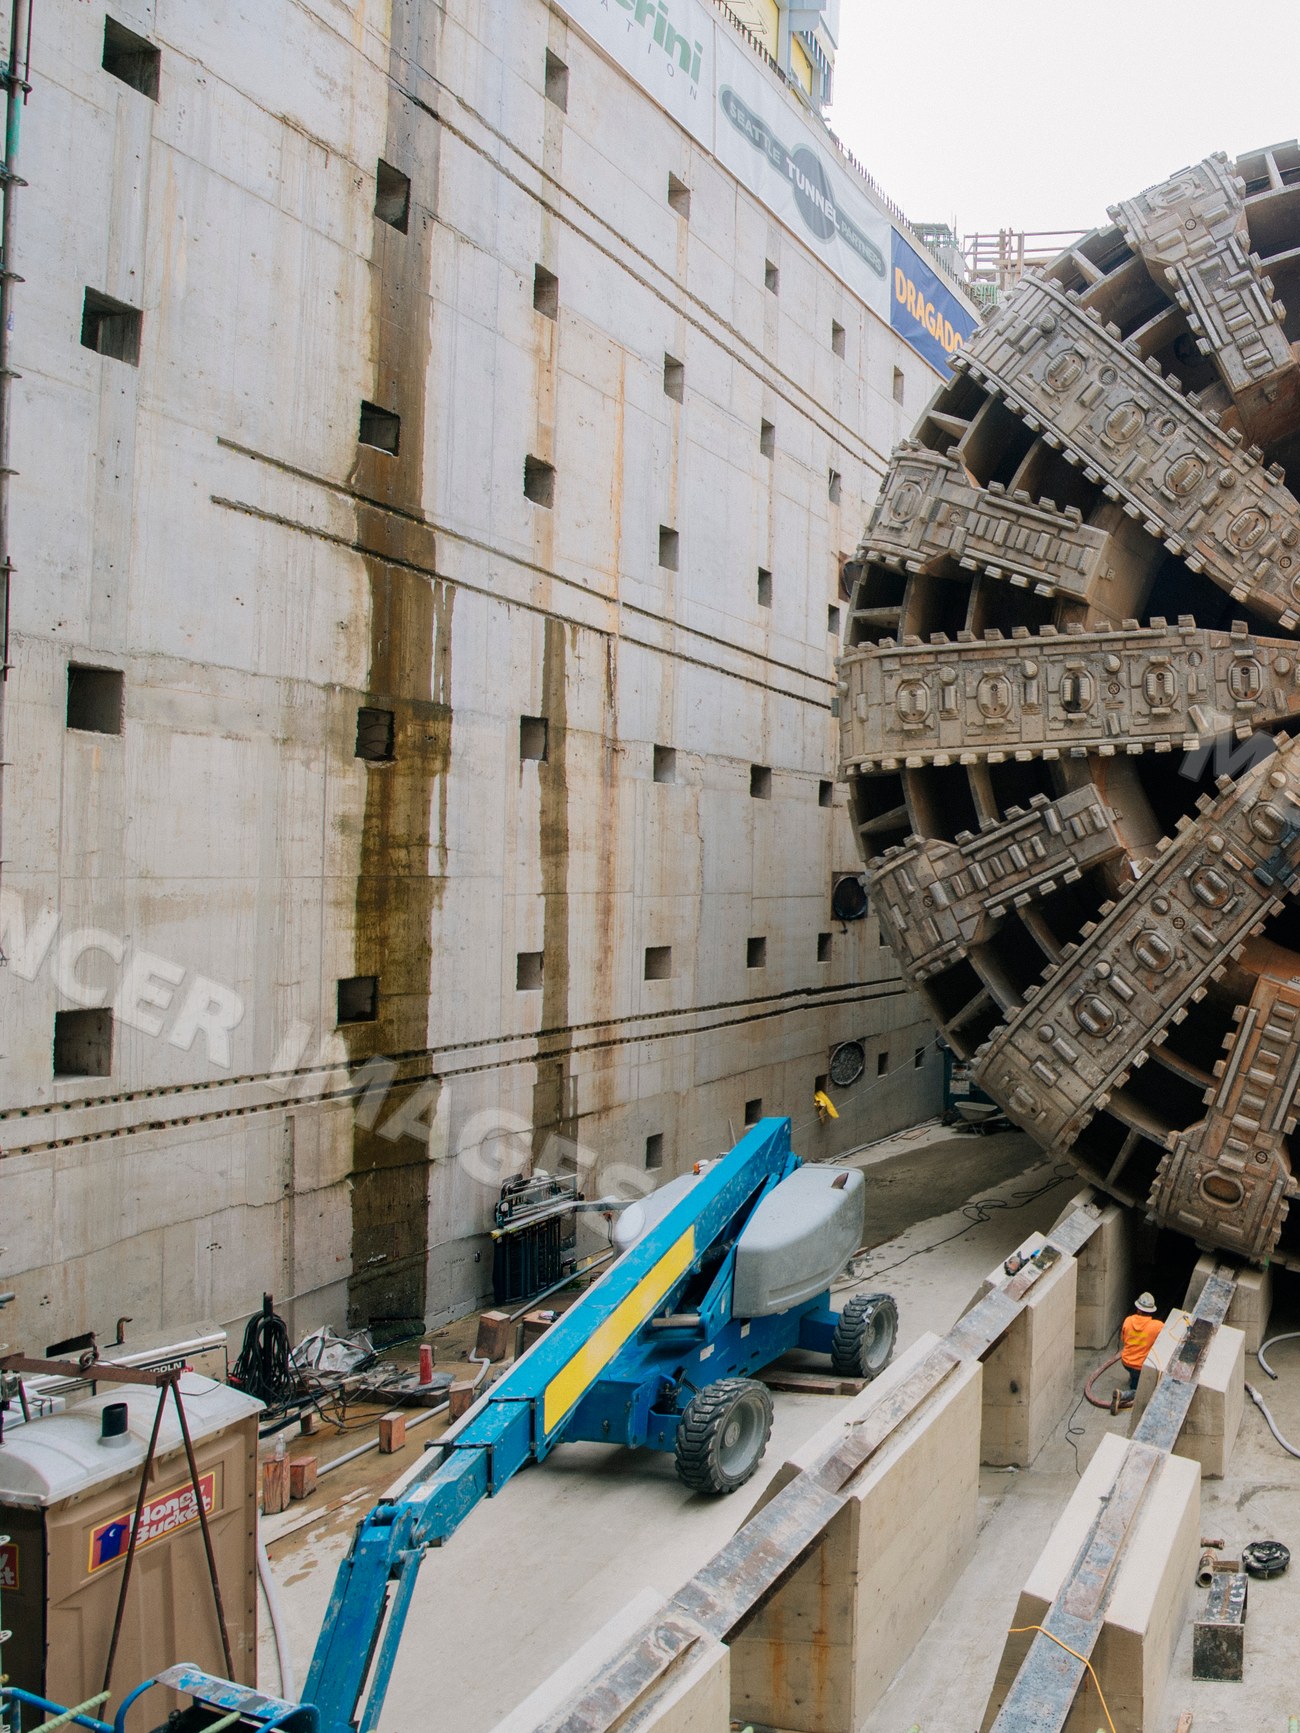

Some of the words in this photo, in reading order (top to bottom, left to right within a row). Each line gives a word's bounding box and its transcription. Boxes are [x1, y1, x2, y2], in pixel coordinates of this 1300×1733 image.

[729, 101, 782, 164] SEATTLE
[785, 157, 840, 229] TUNNEL
[841, 220, 882, 271] PARTNERS
